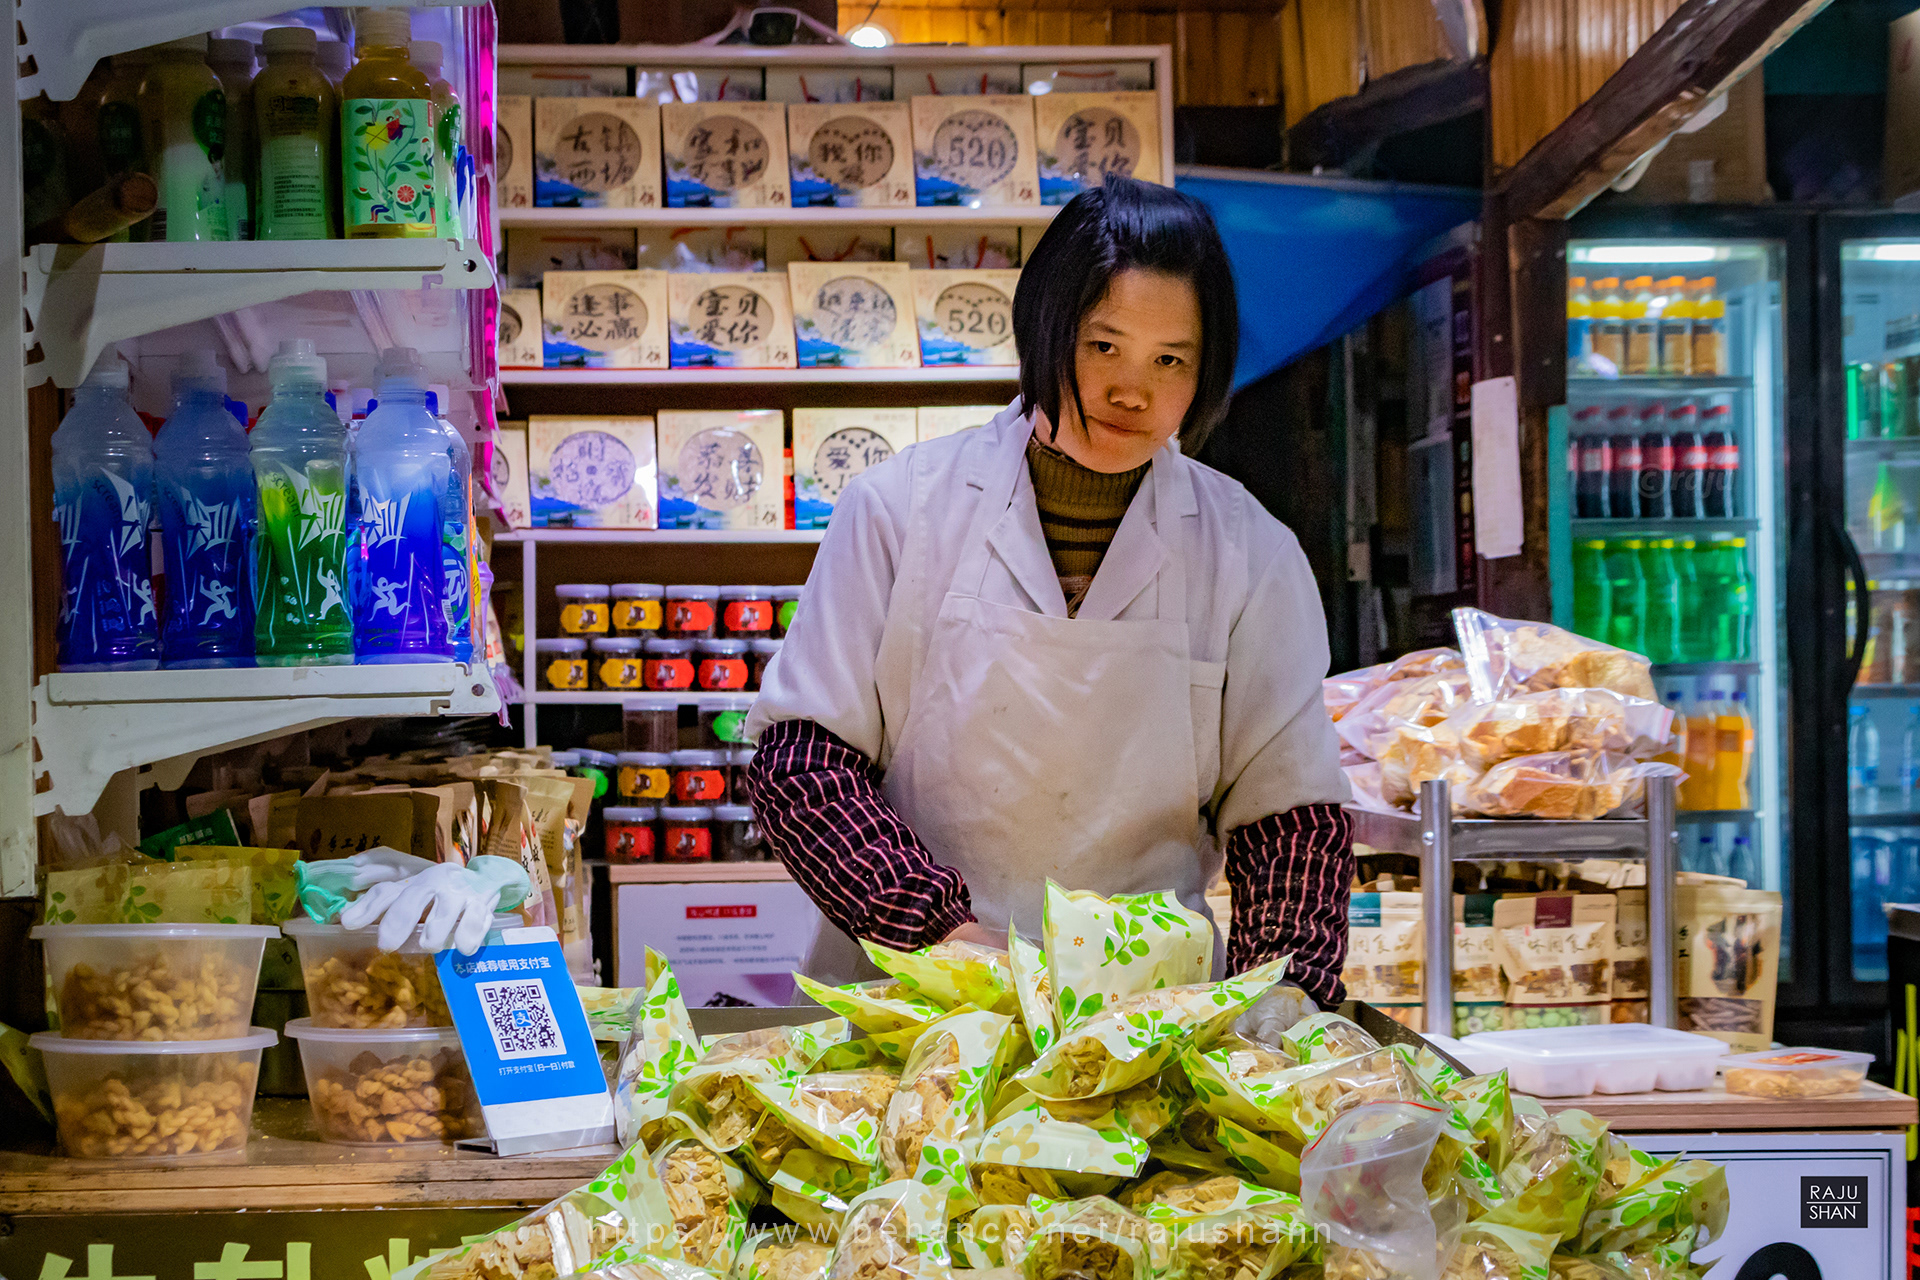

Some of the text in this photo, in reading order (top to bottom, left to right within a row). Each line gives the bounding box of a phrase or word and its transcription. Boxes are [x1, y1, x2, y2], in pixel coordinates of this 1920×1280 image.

[951, 136, 1006, 169] 520
[697, 289, 759, 318] 宝贝
[949, 309, 1007, 335] 520
[270, 472, 300, 518] scream
[454, 956, 552, 974] 本店推荐使用支付宝
